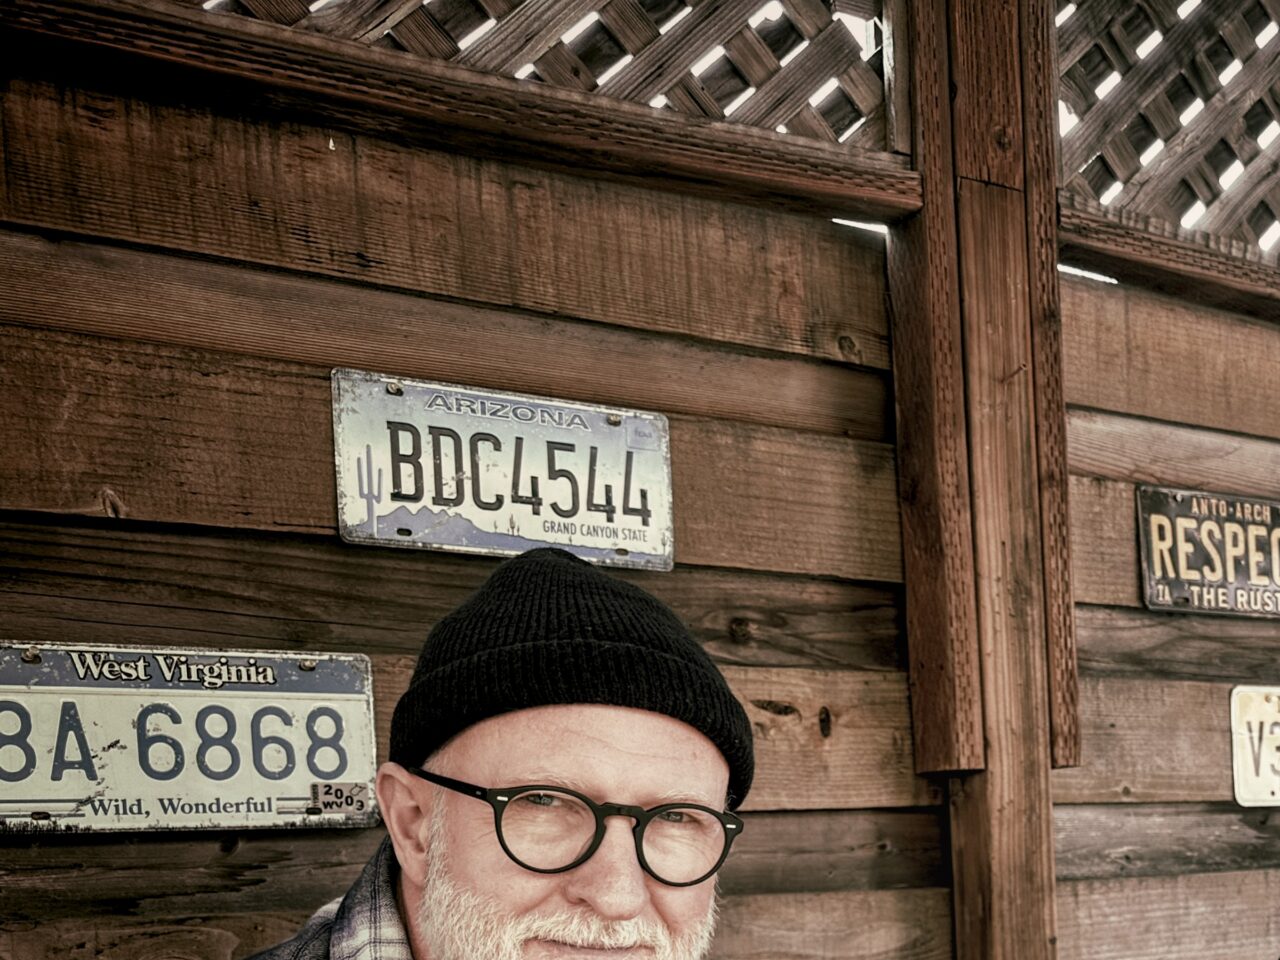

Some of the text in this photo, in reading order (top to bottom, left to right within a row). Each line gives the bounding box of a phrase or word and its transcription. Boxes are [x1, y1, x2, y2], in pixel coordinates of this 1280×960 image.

[425, 393, 591, 431] ARIZONA
[387, 421, 651, 527] BDC4544
[543, 520, 648, 542] GRAND CANYON STATE
[1190, 586, 1228, 608] THE
[69, 651, 276, 687] West Virginia
[137, 703, 348, 781] 6868
[90, 797, 273, 818] Wild, Wonderful
